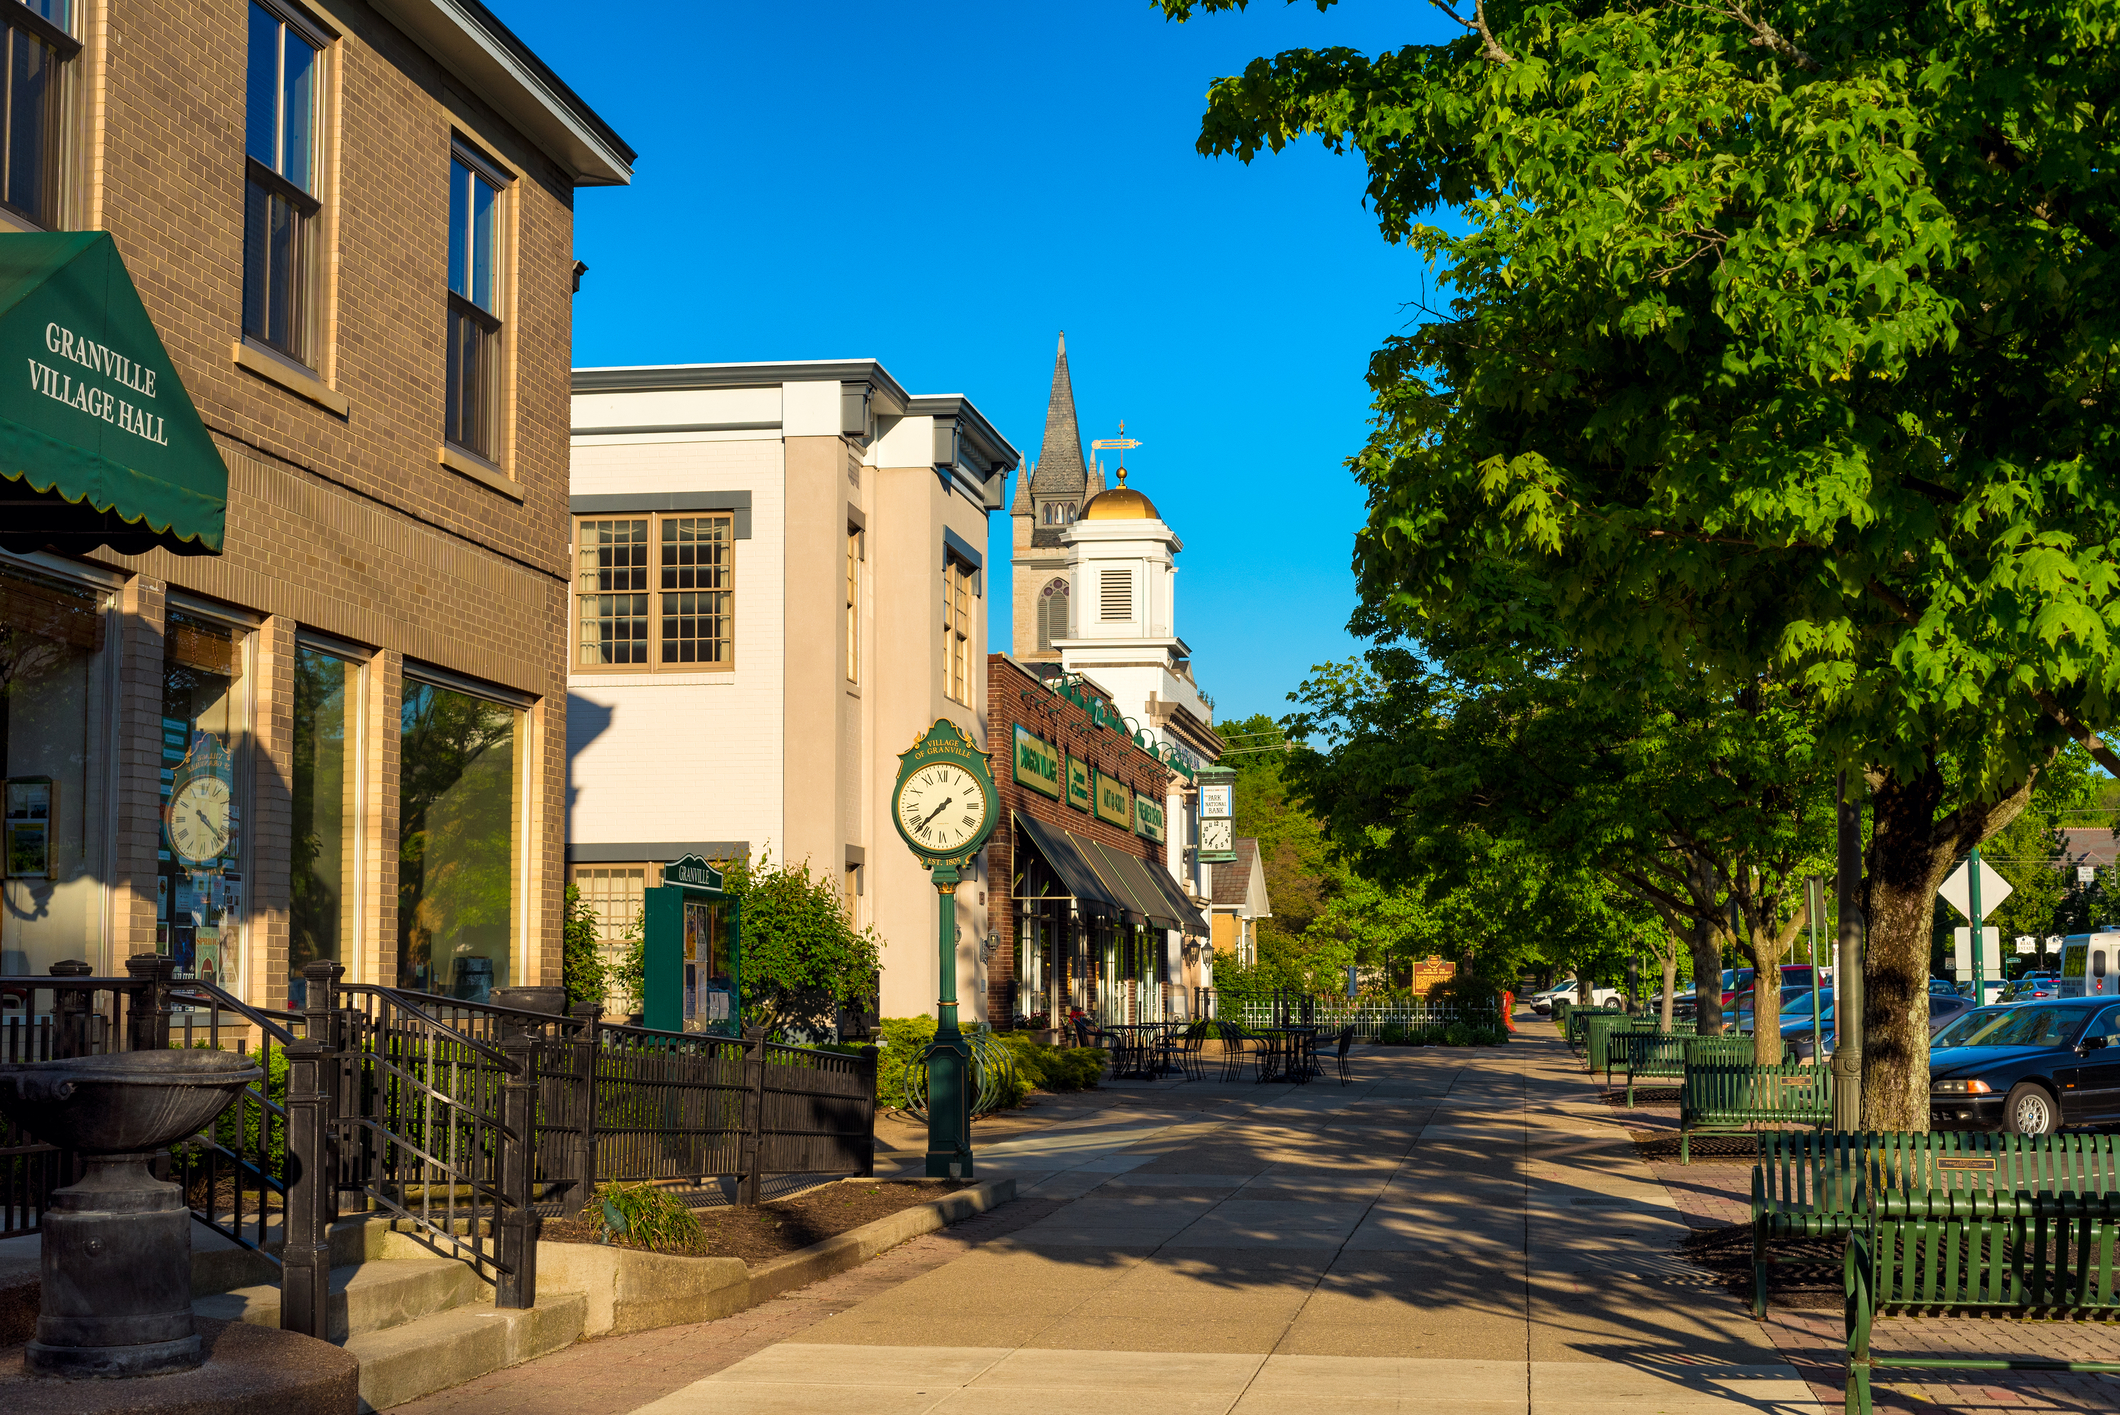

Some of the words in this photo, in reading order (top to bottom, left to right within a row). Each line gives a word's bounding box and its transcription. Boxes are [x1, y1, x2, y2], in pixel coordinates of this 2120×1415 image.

[45, 322, 156, 398] GRANVILLE
[28, 358, 114, 424] VILLAGE
[118, 400, 168, 447] HALL
[927, 739, 959, 747] VILLAGE
[915, 750, 924, 759] OF
[927, 747, 972, 758] GRANVILLE
[937, 770, 948, 782] XII
[963, 786, 974, 796] II
[928, 857, 942, 866] EST.
[946, 857, 961, 866] 1805
[679, 865, 709, 884] GRANVILLE
